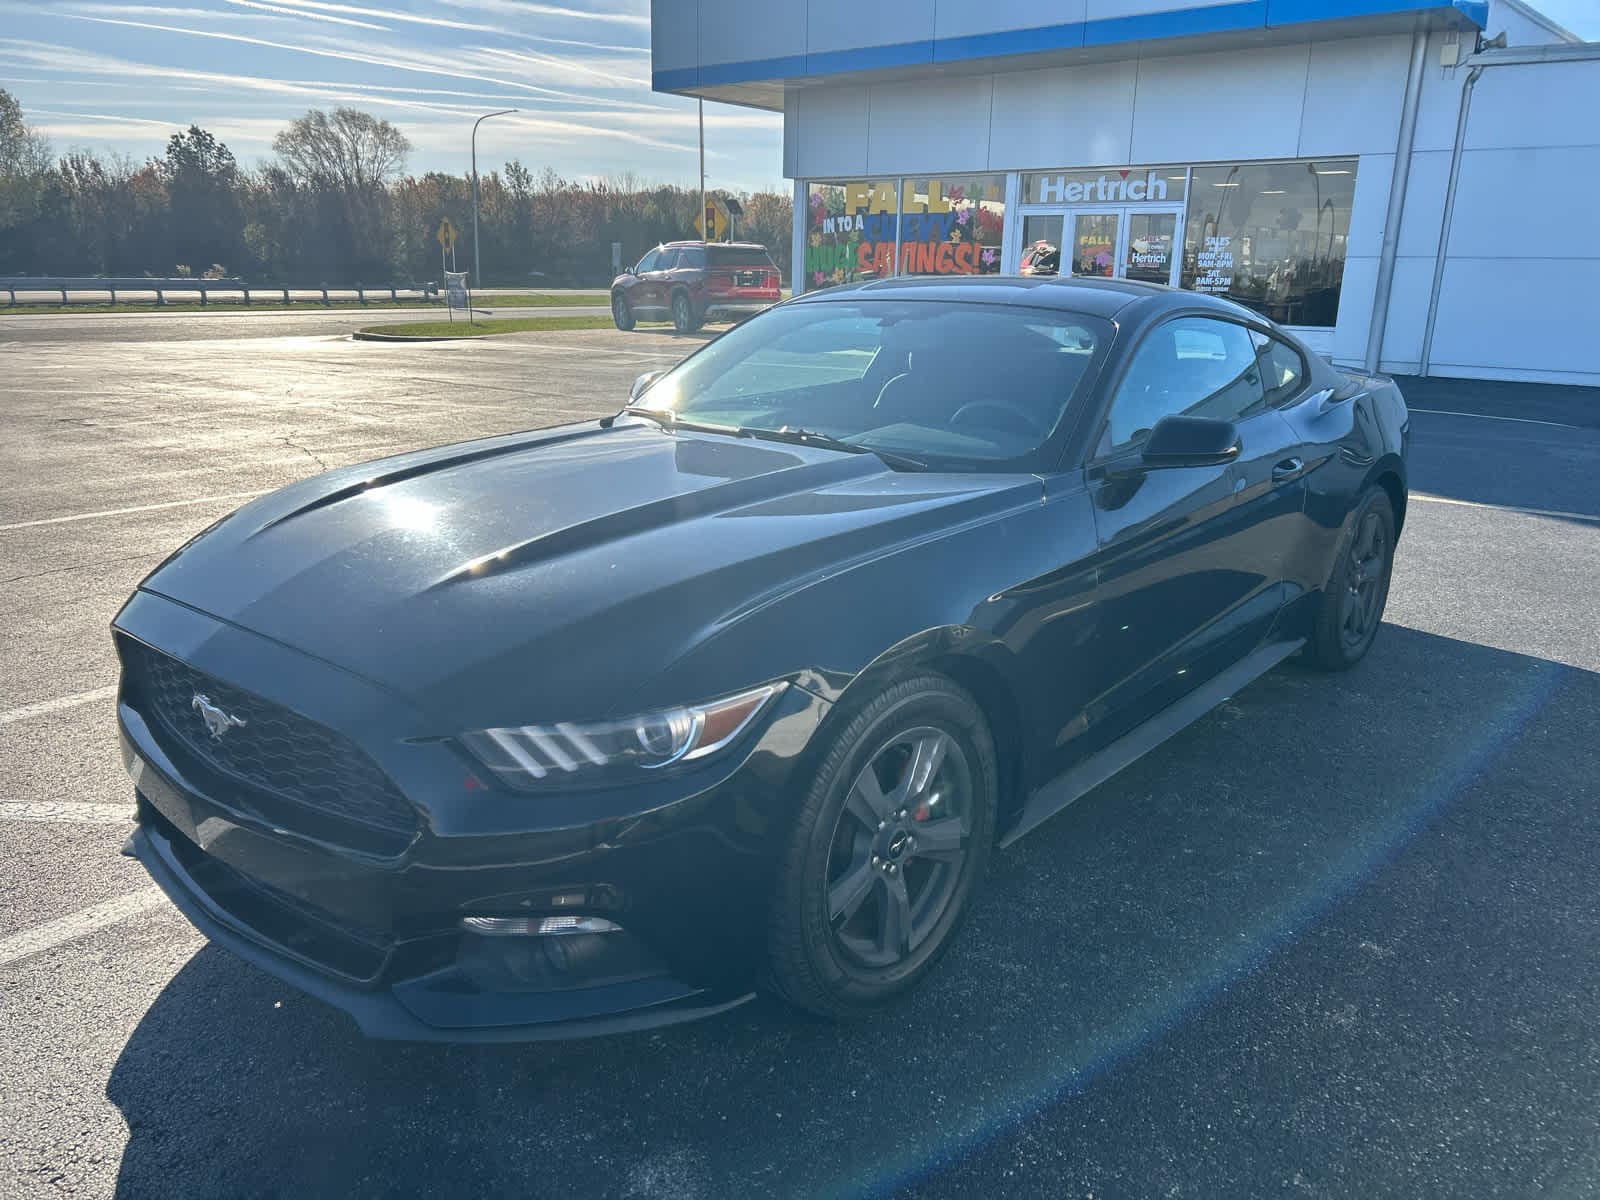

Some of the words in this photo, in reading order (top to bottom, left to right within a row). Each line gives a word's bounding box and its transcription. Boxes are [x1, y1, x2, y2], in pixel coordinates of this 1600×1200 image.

[846, 180, 950, 215] FALL
[1039, 172, 1167, 203] Hertrich
[838, 216, 853, 233] TO
[855, 214, 864, 230] A
[863, 211, 957, 242] CHEVY
[1080, 235, 1111, 246] FALL
[1205, 236, 1230, 247] SALES
[856, 241, 982, 274] SAVINGS!
[1132, 252, 1166, 263] Hertrich
